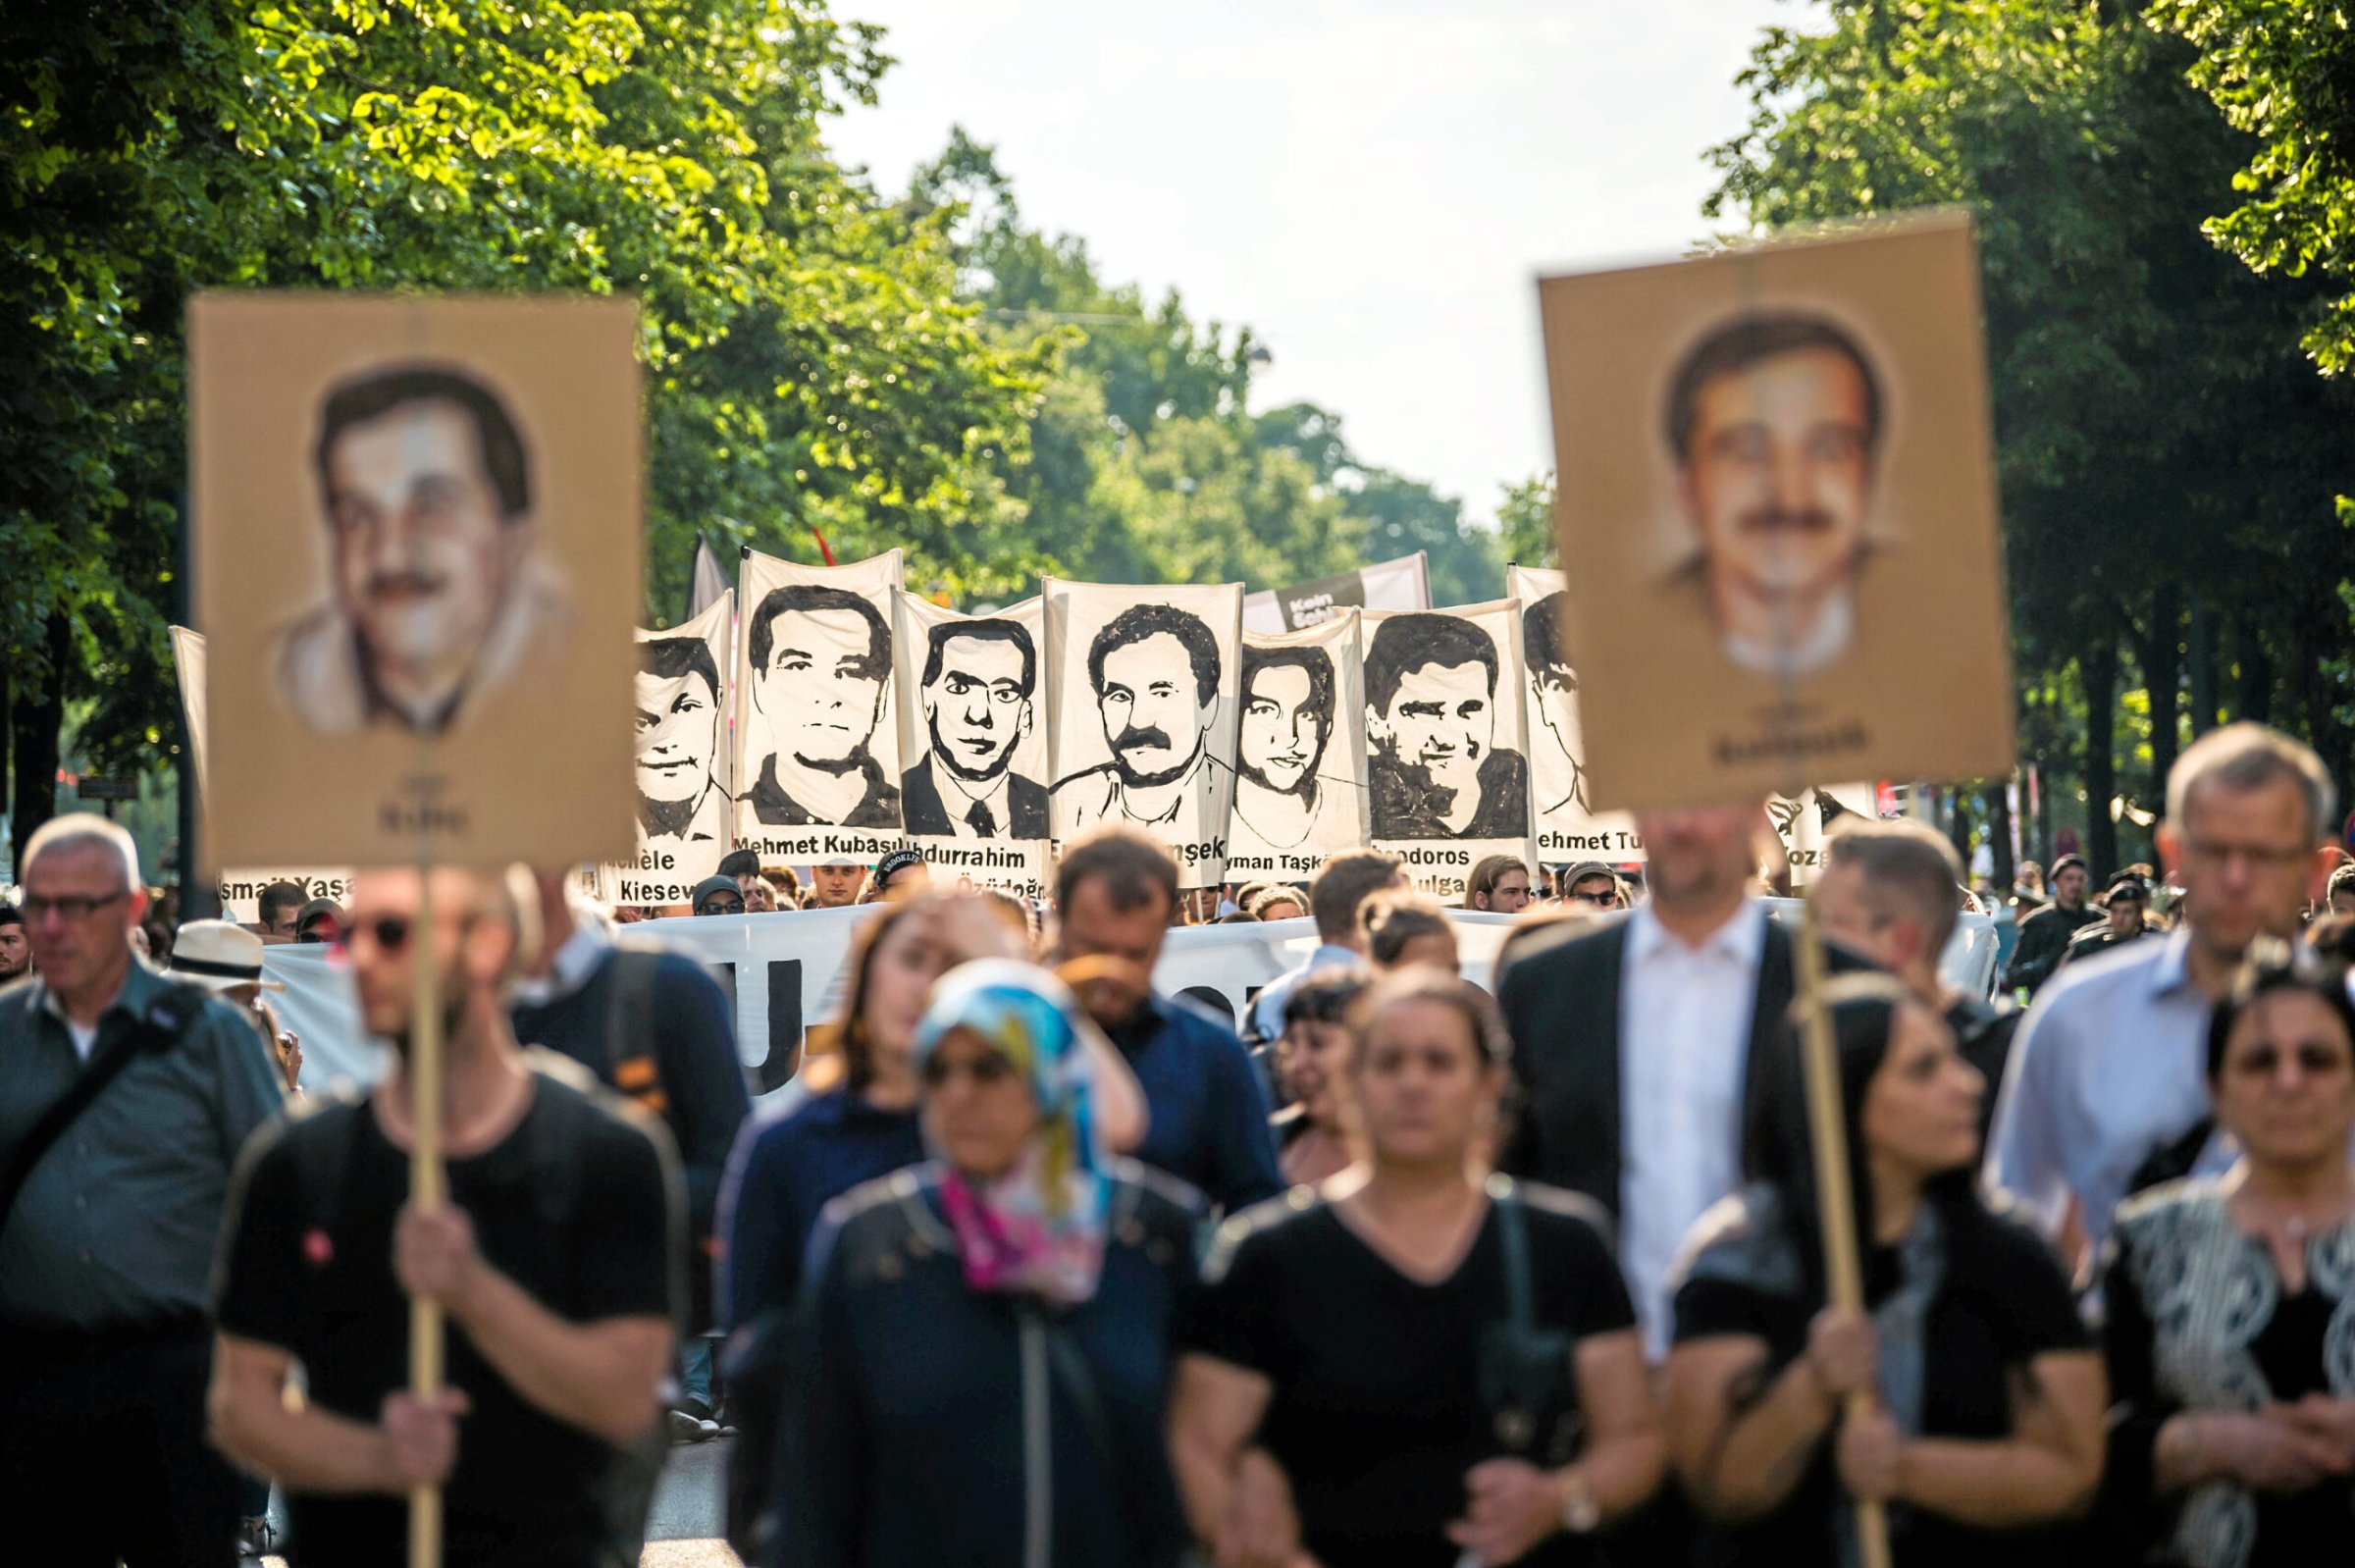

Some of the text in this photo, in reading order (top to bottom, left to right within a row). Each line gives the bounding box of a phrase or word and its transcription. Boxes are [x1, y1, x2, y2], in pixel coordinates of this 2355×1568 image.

[734, 835, 818, 855] Mehmet
[1538, 830, 1610, 850] ehmet
[883, 853, 919, 872] BROOKLYN
[907, 841, 1025, 868] bdurrahim
[1372, 844, 1470, 865] odoros
[221, 877, 286, 900] sma
